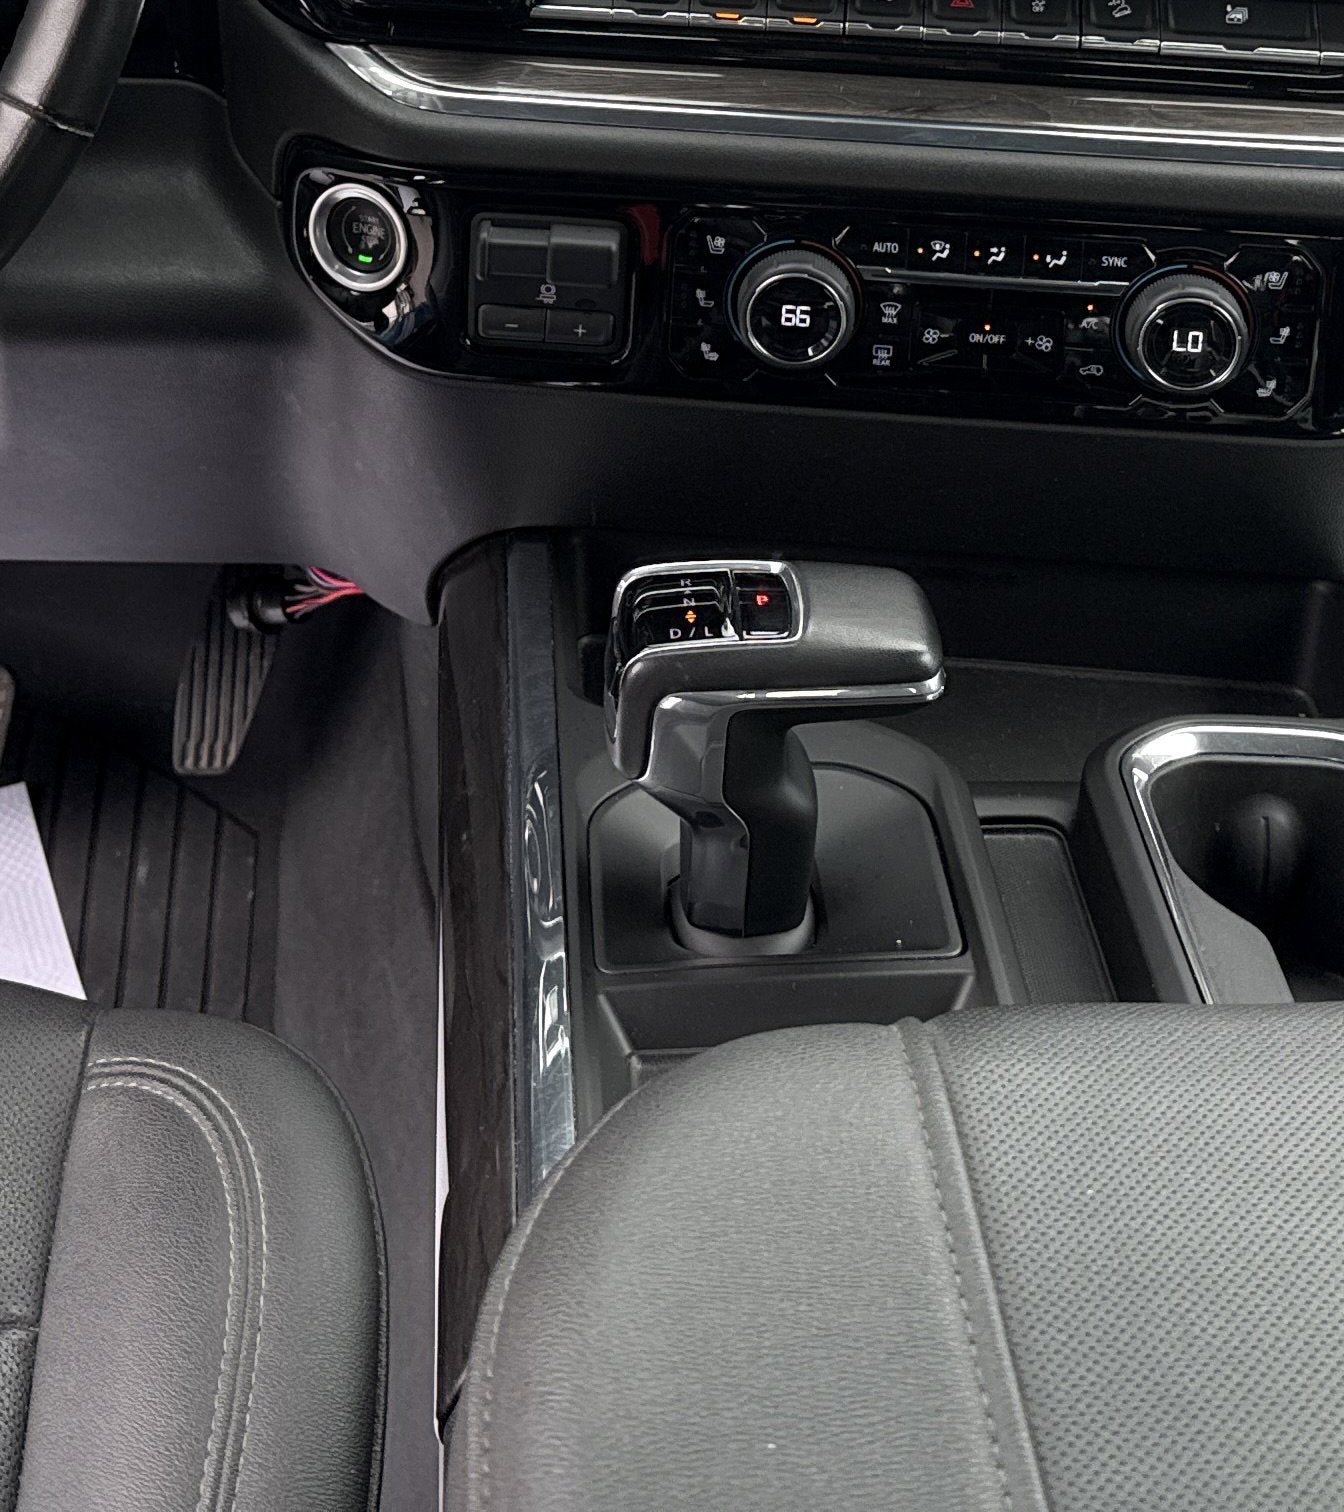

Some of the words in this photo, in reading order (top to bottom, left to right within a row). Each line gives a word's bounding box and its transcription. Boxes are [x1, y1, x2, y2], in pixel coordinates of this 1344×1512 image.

[351, 221, 386, 241] ENGINE
[872, 242, 899, 254] AUTO
[1101, 256, 1128, 268] SYNC
[780, 304, 812, 328] 66
[1080, 318, 1099, 330] A/C
[968, 333, 1006, 345] ON/OFF
[1172, 329, 1204, 353] LO
[872, 358, 891, 367] REAR
[680, 578, 693, 587] R
[682, 597, 696, 607] N
[756, 594, 769, 606] P
[669, 628, 682, 639] D
[705, 626, 714, 637] L
